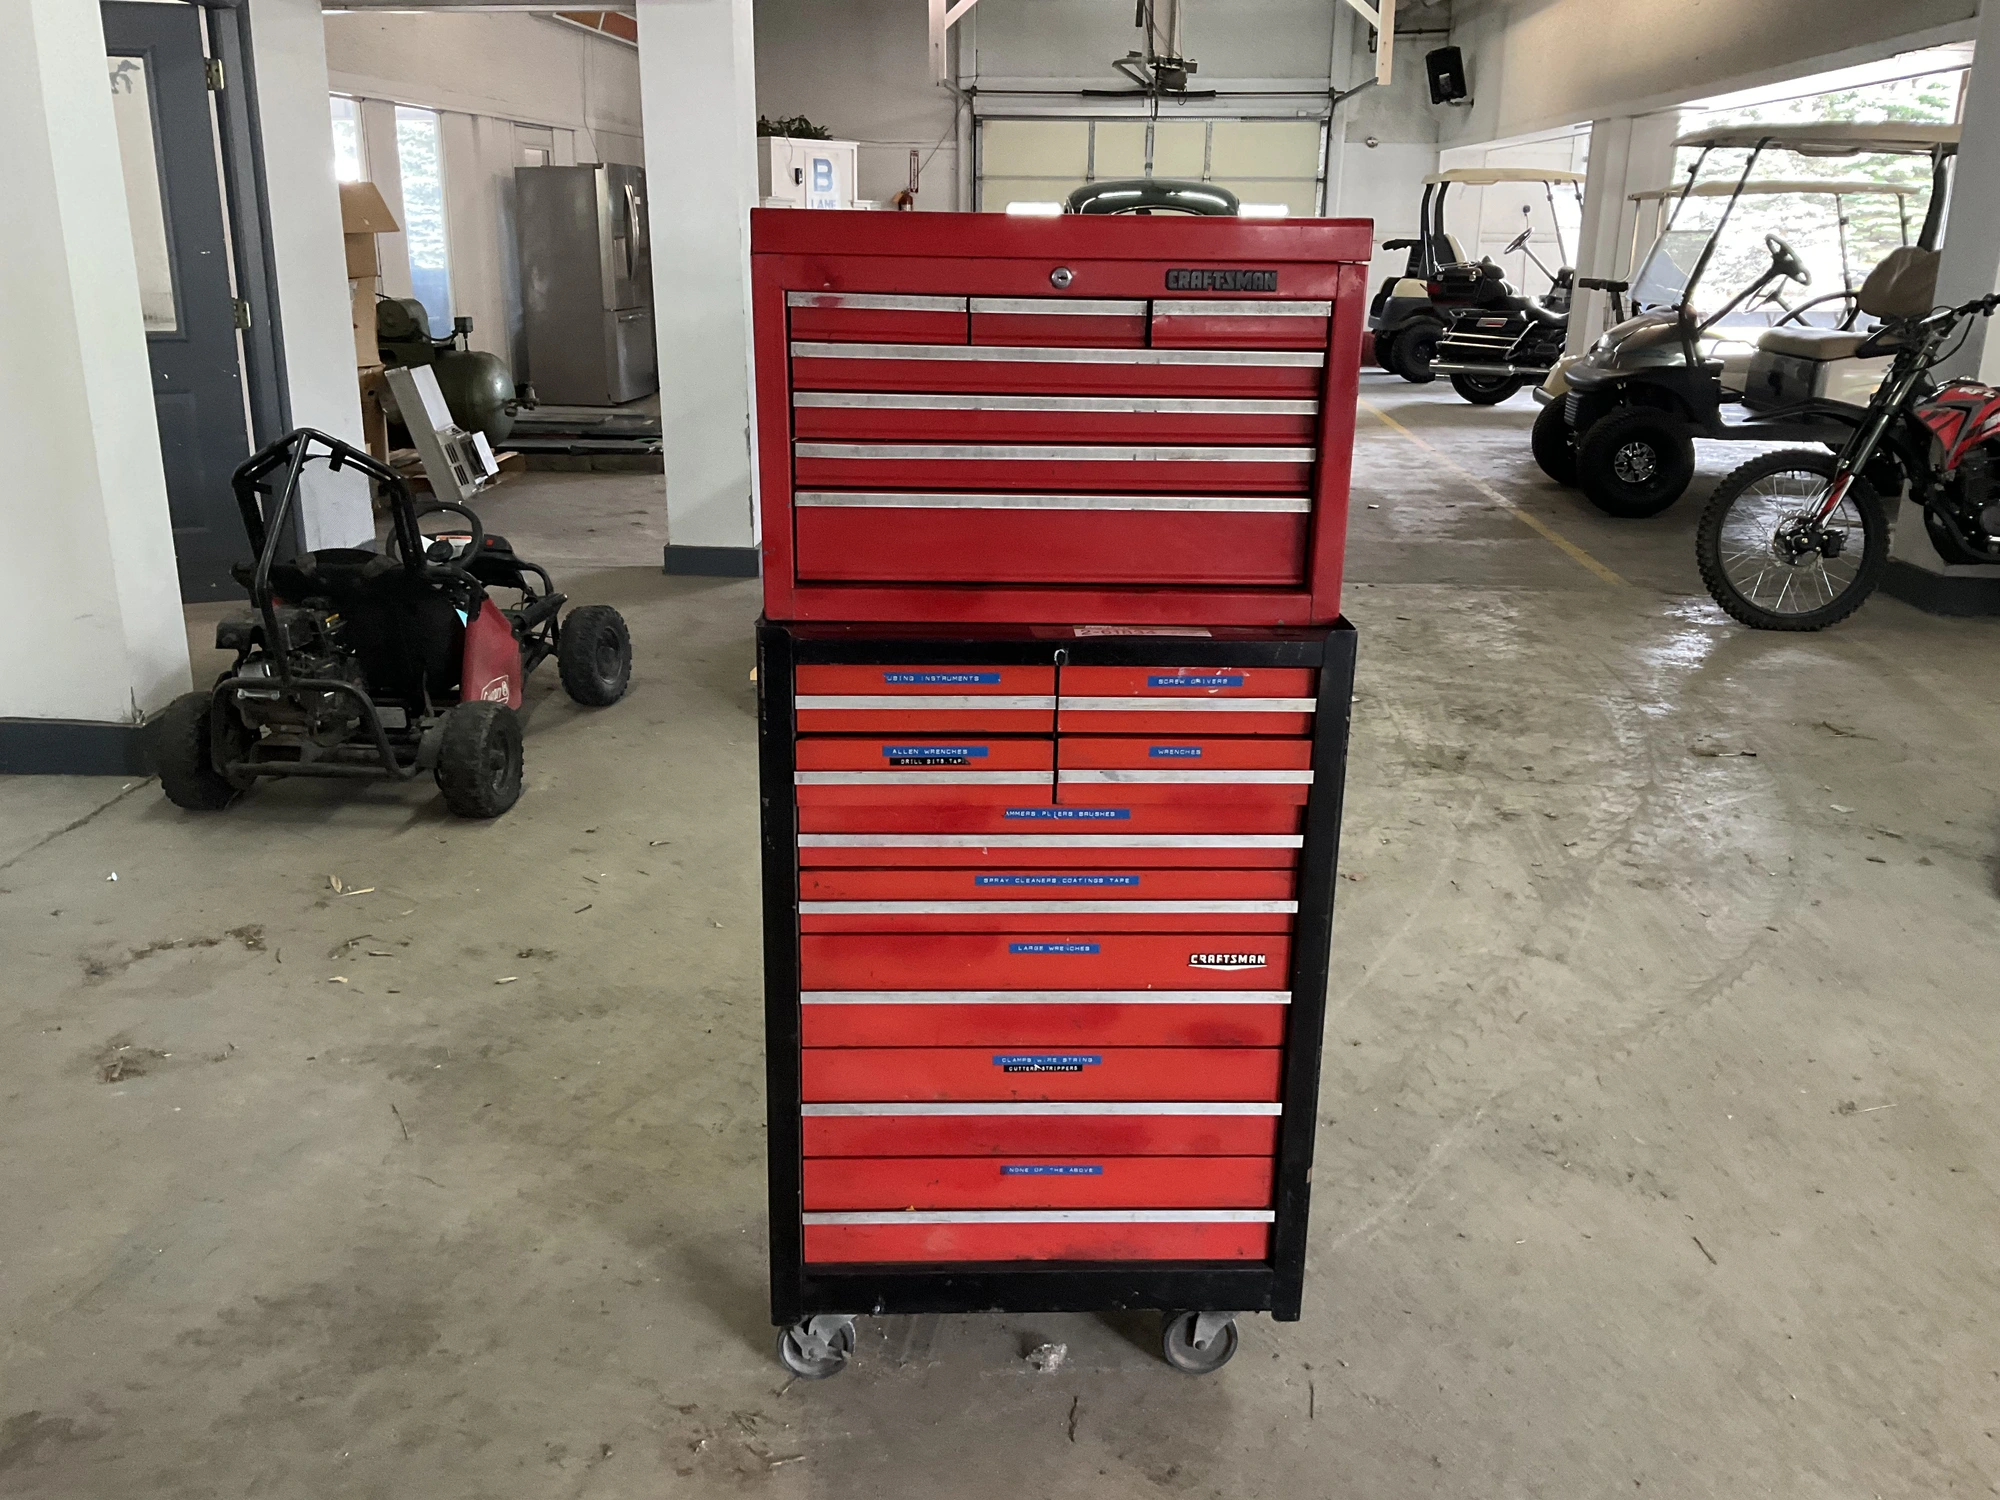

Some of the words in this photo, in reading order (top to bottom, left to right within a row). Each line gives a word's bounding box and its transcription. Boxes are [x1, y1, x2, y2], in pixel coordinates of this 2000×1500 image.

[812, 158, 834, 192] B
[1166, 269, 1277, 292] CRAFTSMAN
[1190, 954, 1266, 964] CRAFTSMAN
